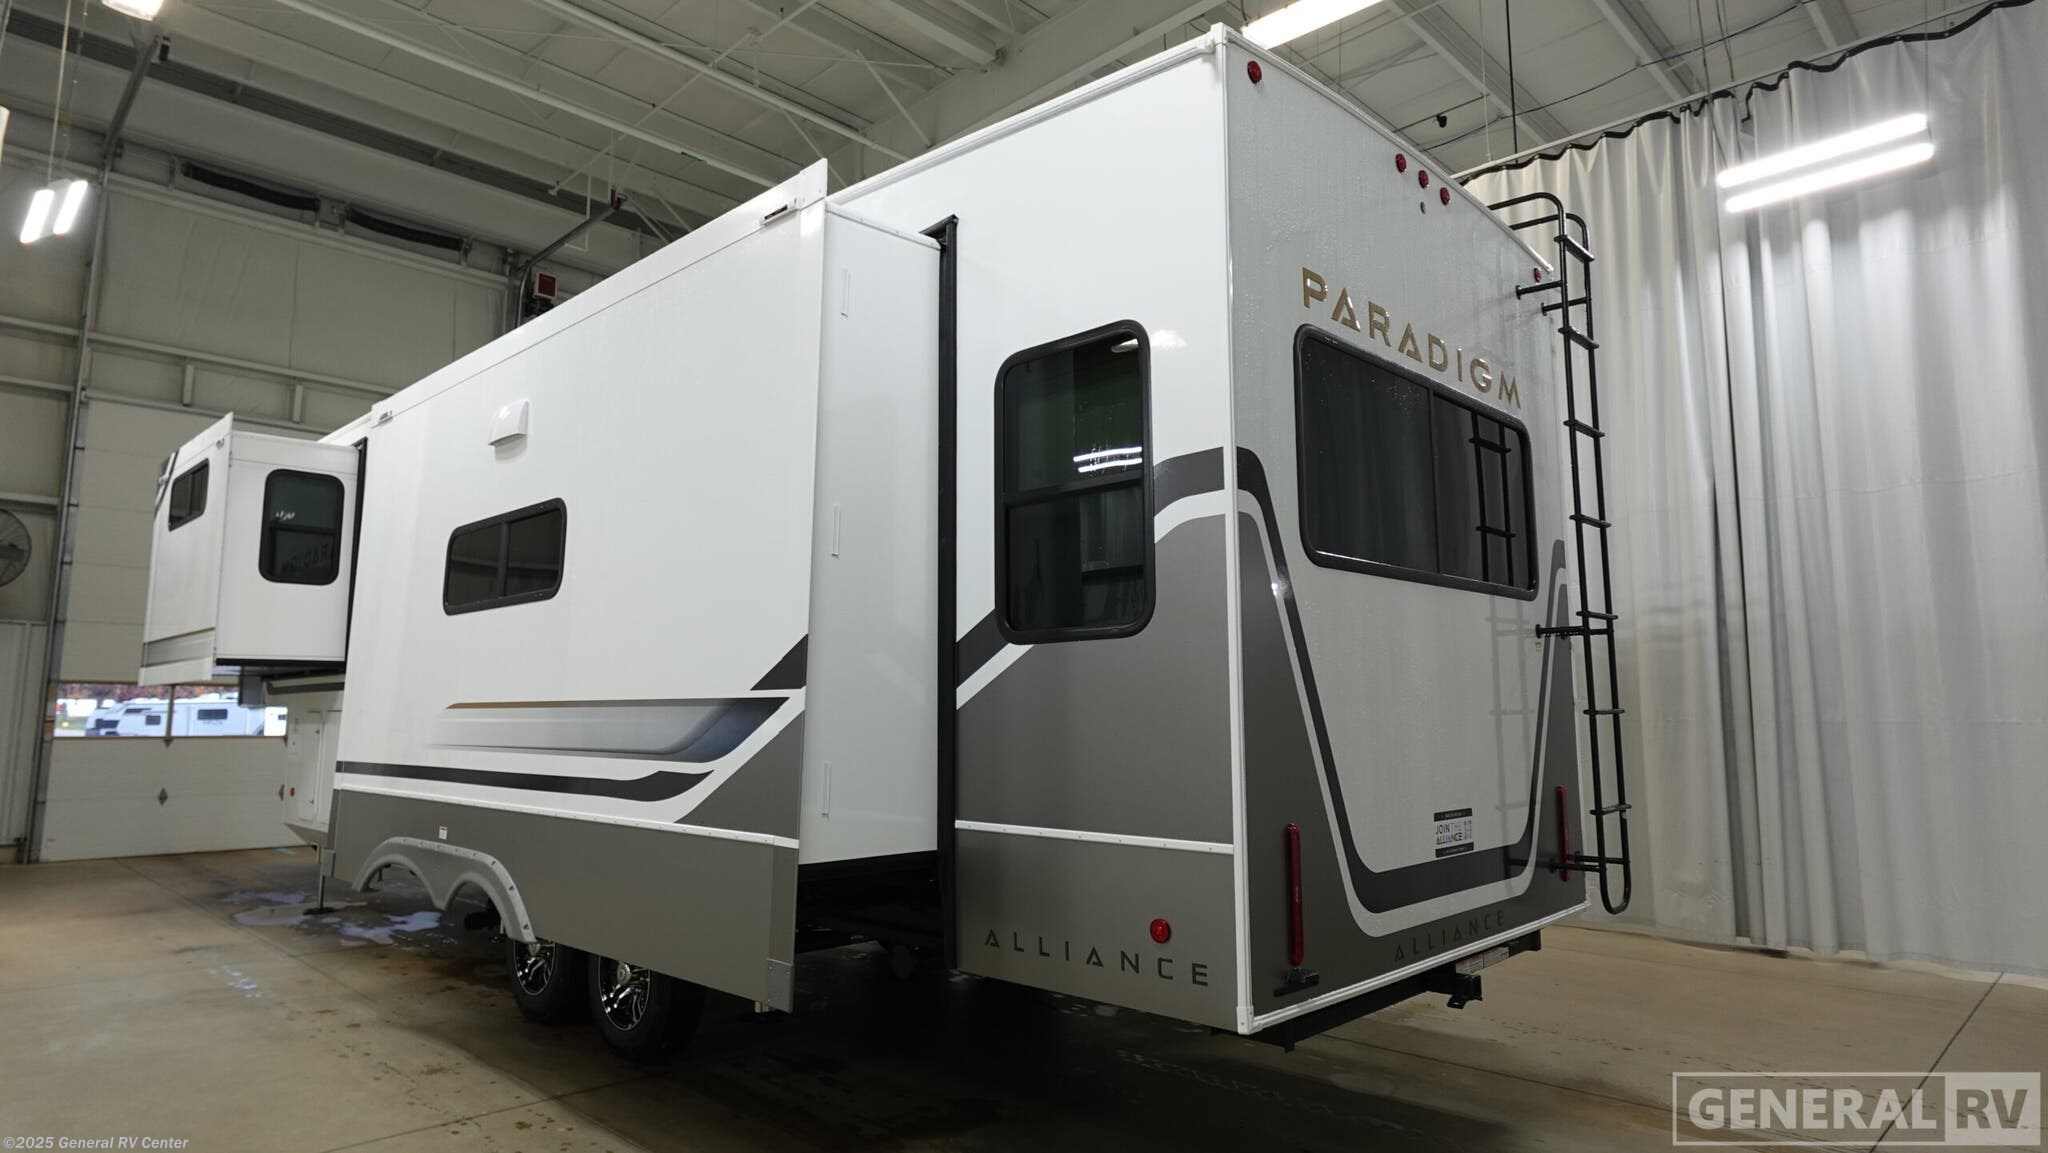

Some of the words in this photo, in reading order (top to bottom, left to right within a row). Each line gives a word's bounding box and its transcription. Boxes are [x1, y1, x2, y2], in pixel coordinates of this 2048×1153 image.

[1302, 267, 1521, 408] PARADIGM
[1436, 824, 1449, 835] JOIN
[984, 929, 1208, 986] ALLIANCE
[1395, 910, 1504, 960] ALLIANCE
